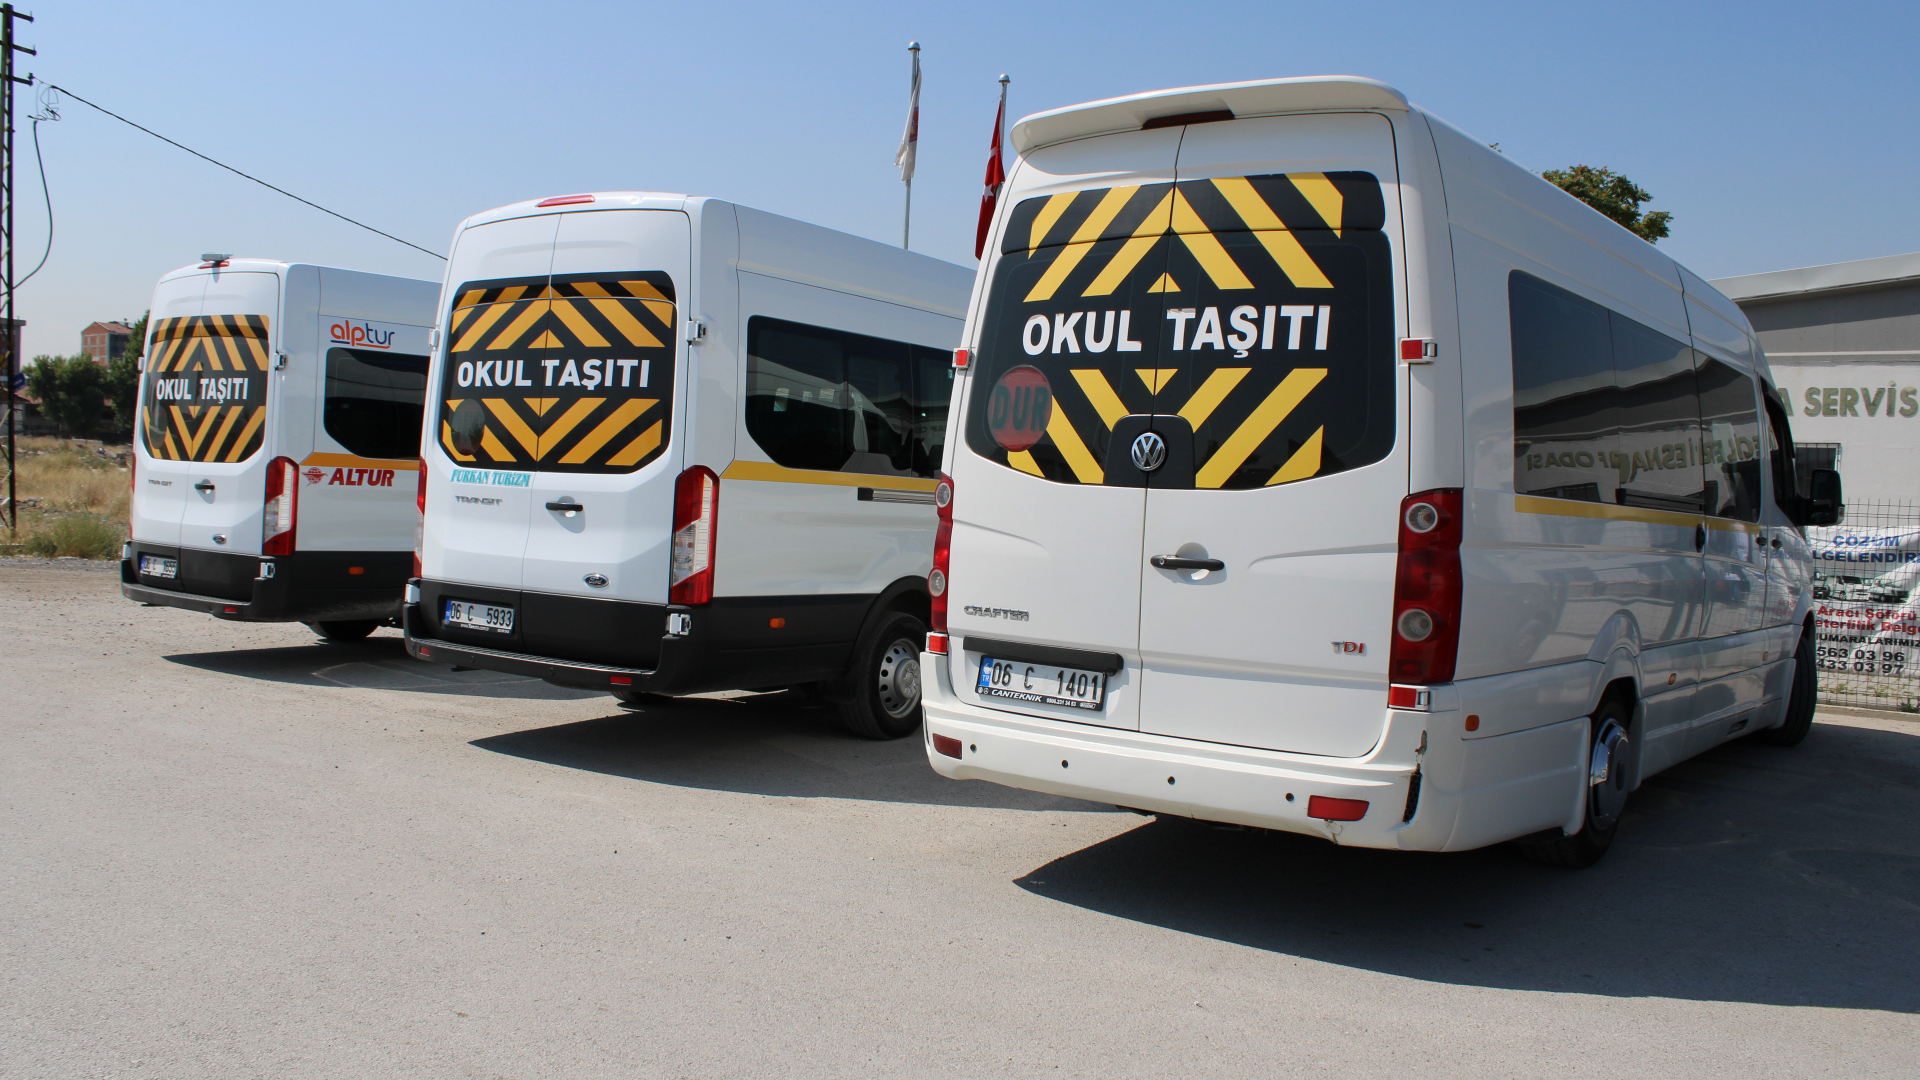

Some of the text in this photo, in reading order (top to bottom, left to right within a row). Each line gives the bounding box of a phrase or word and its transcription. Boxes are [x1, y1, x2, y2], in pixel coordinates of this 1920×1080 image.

[331, 319, 395, 347] alptur
[1022, 304, 1331, 358] OKUL TAŞITI
[457, 358, 650, 391] OKUL TAŞITI
[156, 377, 249, 404] OKUL TAŞITI
[1803, 380, 1919, 418] SERVİS
[991, 385, 1049, 432] DUR
[328, 467, 395, 487] ALTUR
[450, 468, 491, 485] FURKAN
[455, 495, 503, 506] TRANSIT
[1832, 533, 1900, 547] ÇÖZÜM
[450, 602, 462, 620] 06
[467, 605, 474, 622] C
[486, 607, 512, 628] 5933
[963, 605, 1029, 622] CRAFTER
[1817, 605, 1859, 618] Aracı
[1331, 640, 1365, 654] TDI
[1816, 646, 1905, 662] 563 03 96
[1853, 661, 1875, 672] 03
[1881, 663, 1904, 674] 97
[991, 661, 1099, 700] 06 C 1401
